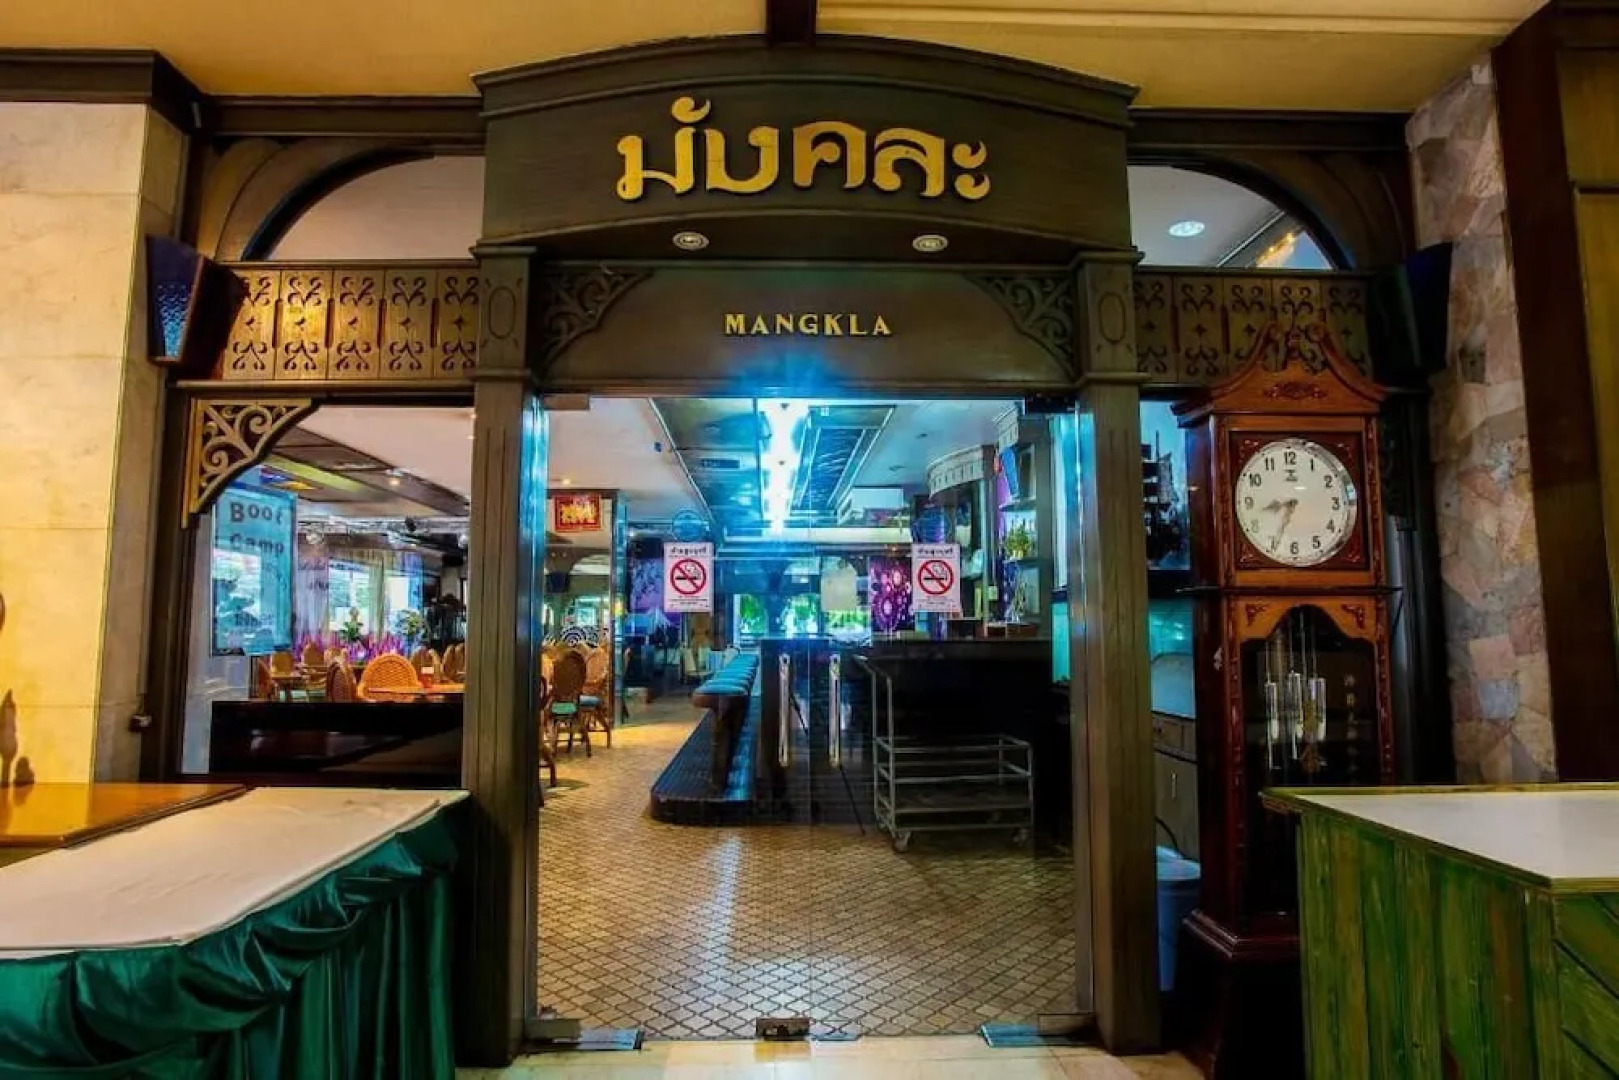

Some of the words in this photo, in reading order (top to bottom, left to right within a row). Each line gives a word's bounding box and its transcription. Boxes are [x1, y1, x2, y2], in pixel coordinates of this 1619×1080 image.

[616, 97, 991, 200] มังคละ
[724, 313, 892, 337] MANGKLA
[1264, 457, 1275, 471] 11
[1284, 452, 1297, 465] 12
[1310, 459, 1315, 471] 1
[1249, 473, 1262, 487] 10
[1323, 475, 1333, 488] 2
[1244, 496, 1254, 510] 9
[1331, 496, 1340, 510] 3
[1325, 519, 1335, 533] 4
[1289, 541, 1299, 555] 6
[1312, 535, 1322, 549] 5
